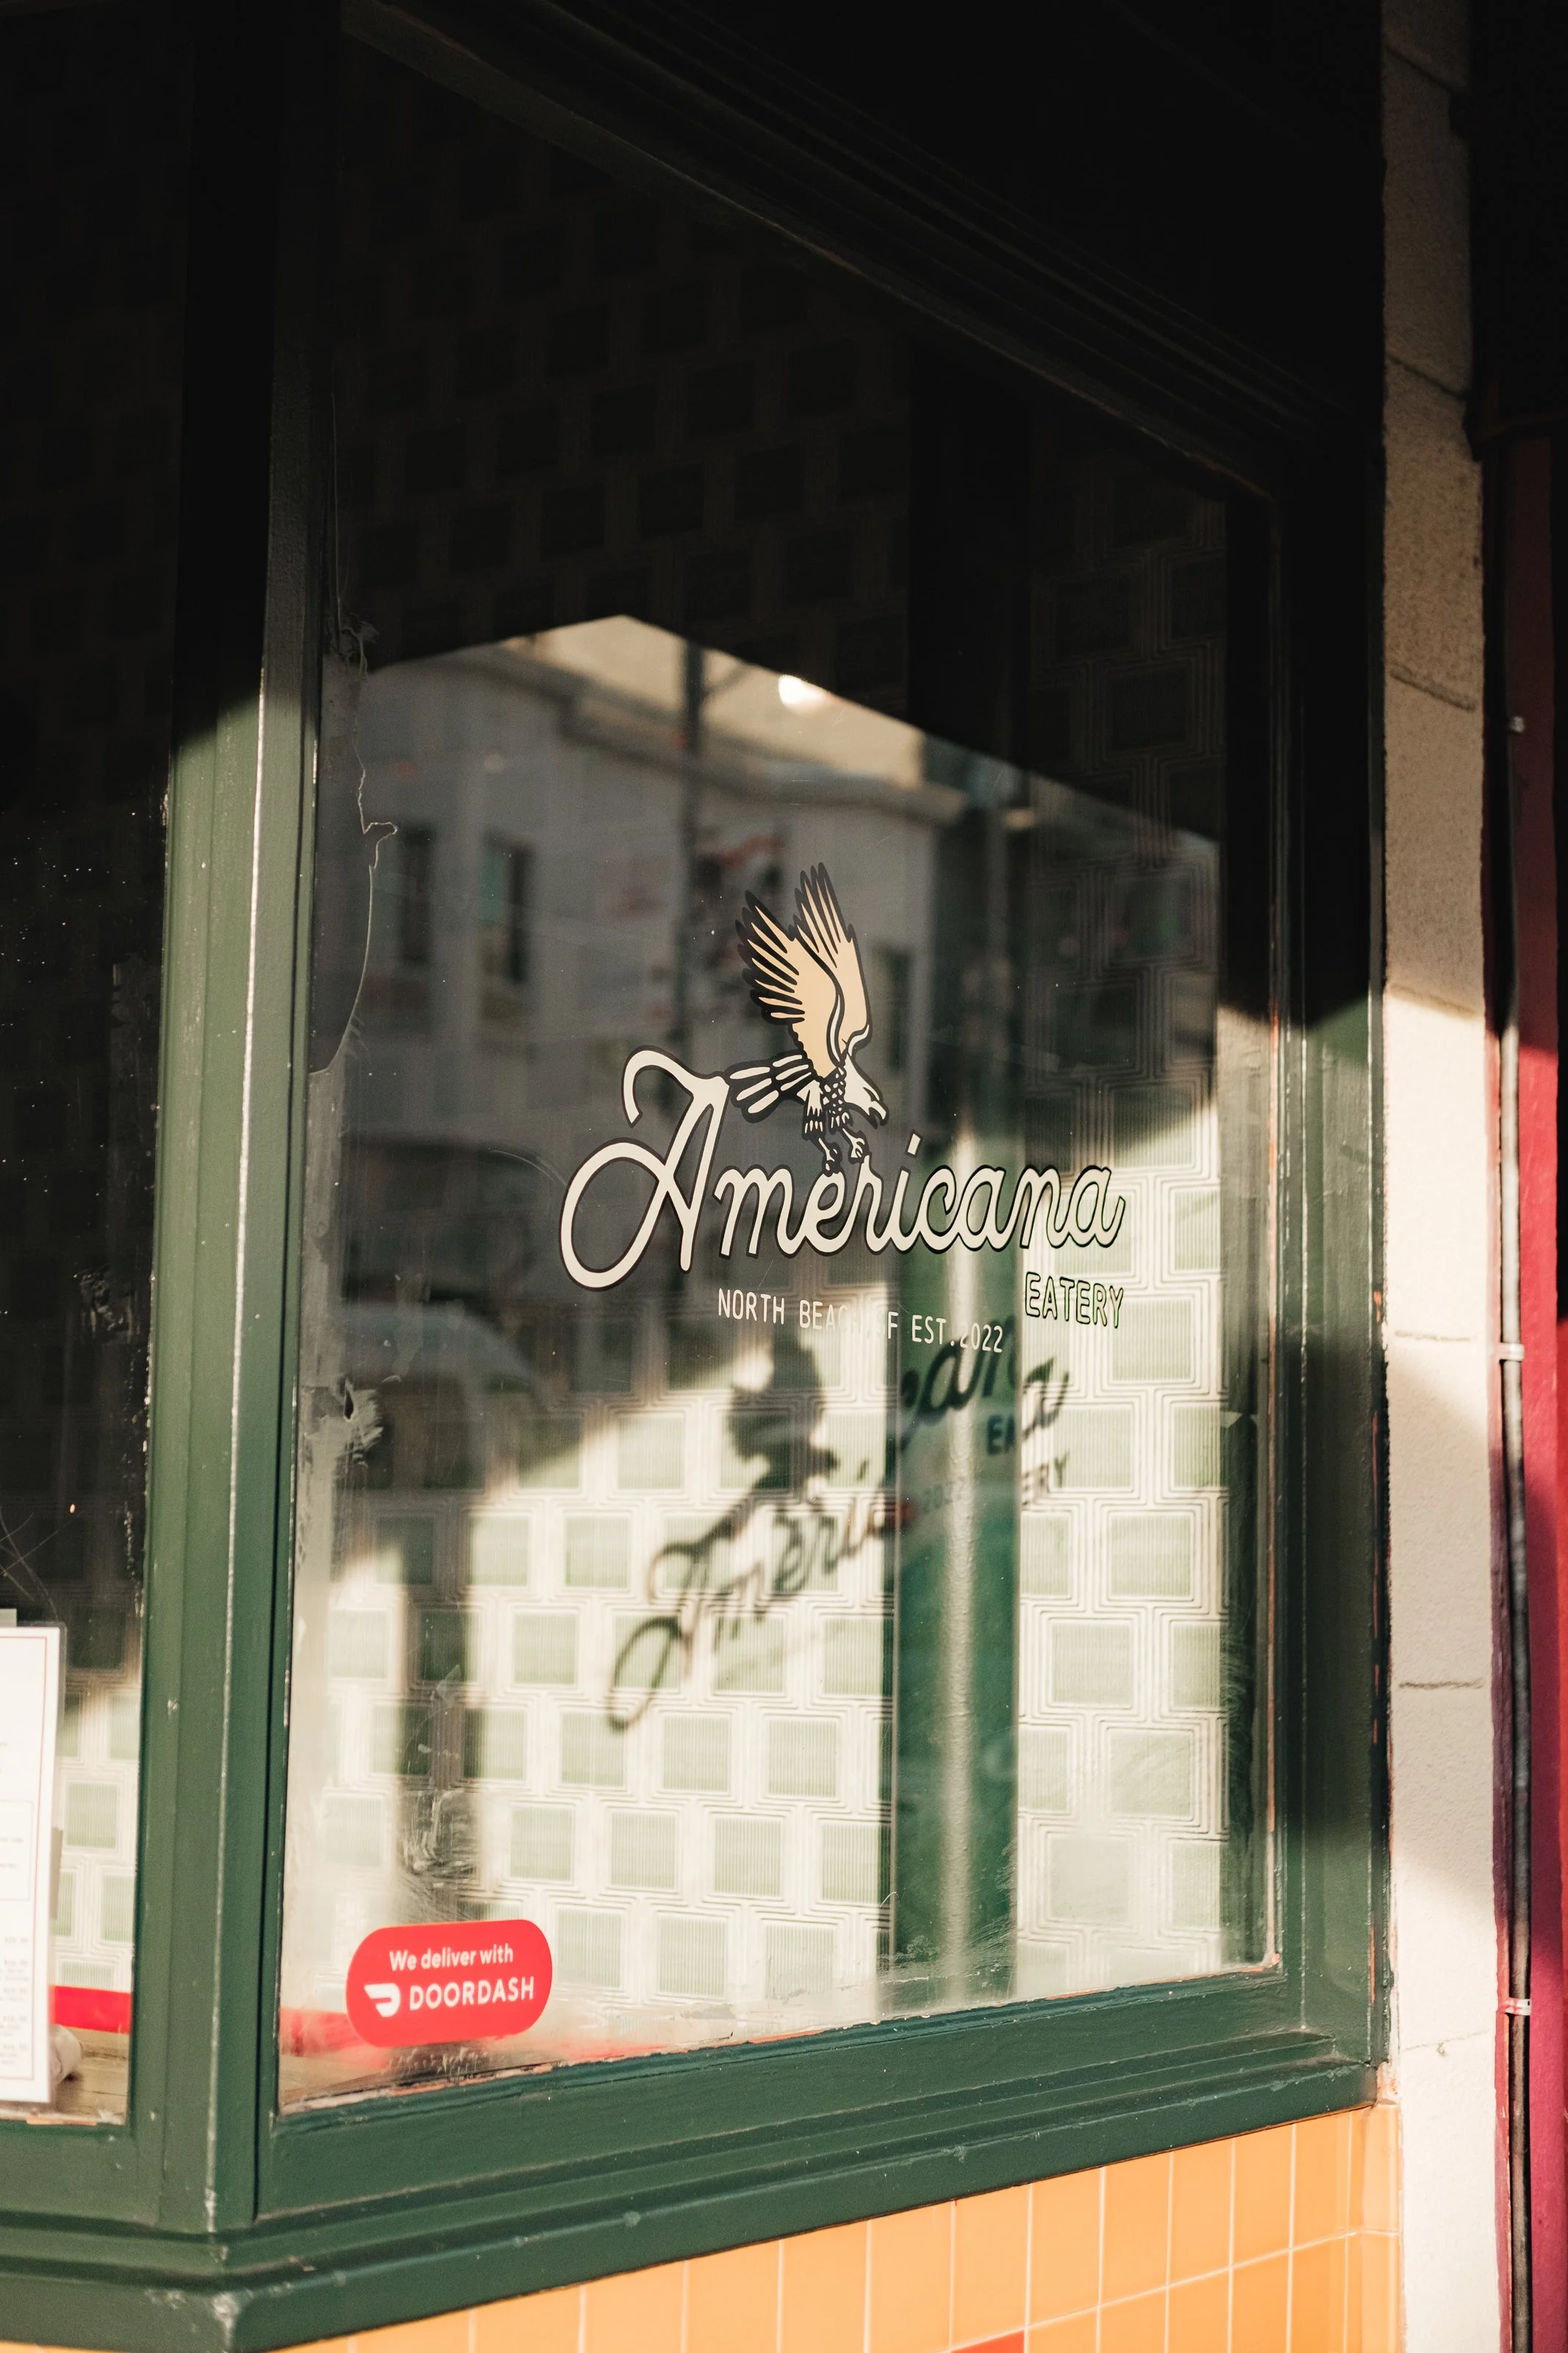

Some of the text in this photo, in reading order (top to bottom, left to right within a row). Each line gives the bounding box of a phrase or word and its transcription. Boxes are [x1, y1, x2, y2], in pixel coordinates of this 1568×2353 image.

[560, 1046, 1126, 1291] Americana
[717, 1288, 785, 1325] NORTH
[1025, 1271, 1124, 1329] EATERY
[389, 1943, 514, 1972] We deliver with
[409, 1976, 534, 2011] DOORDASH
